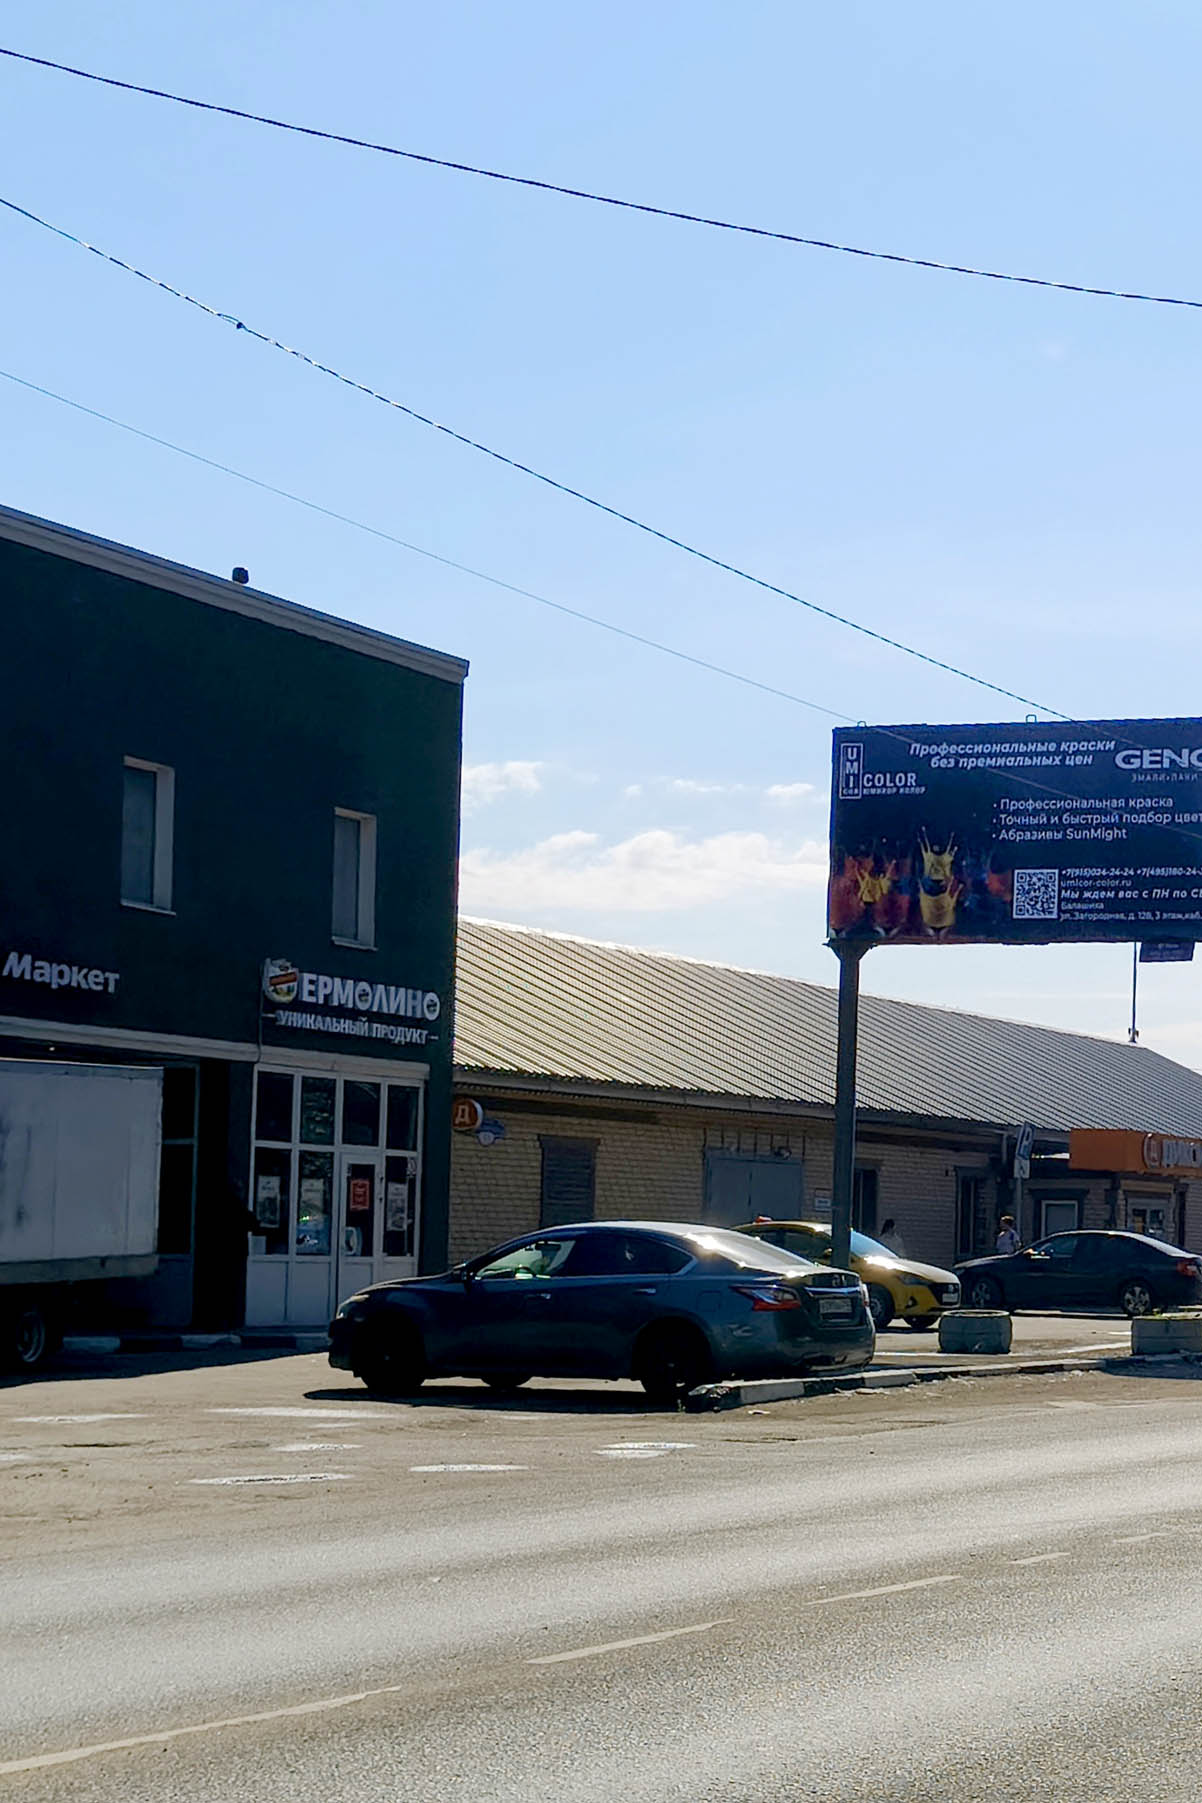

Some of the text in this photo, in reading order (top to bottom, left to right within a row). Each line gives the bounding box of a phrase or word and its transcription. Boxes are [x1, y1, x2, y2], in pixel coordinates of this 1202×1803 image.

[909, 740, 1116, 758] Профессиональные краски
[930, 753, 1093, 770] без премиальных цен
[863, 772, 917, 788] COLOR
[1000, 797, 1174, 812] Профессиональная краска
[999, 813, 1048, 826] Точный
[1050, 815, 1059, 825] и
[1062, 812, 1120, 827] быстрый
[1122, 811, 1172, 826] подбор
[999, 827, 1128, 842] Абразивы SunMight
[1060, 889, 1080, 899] Мы
[1082, 889, 1115, 899] ждем
[1118, 890, 1140, 898] вас
[1152, 888, 1170, 899] ПН
[1172, 889, 1188, 898] по
[2, 951, 120, 993] Маркет
[302, 972, 441, 1021] ЕРМОЛИНО
[276, 1010, 429, 1045] УНИКАЛЬНЫЙ ПРОДУКТ
